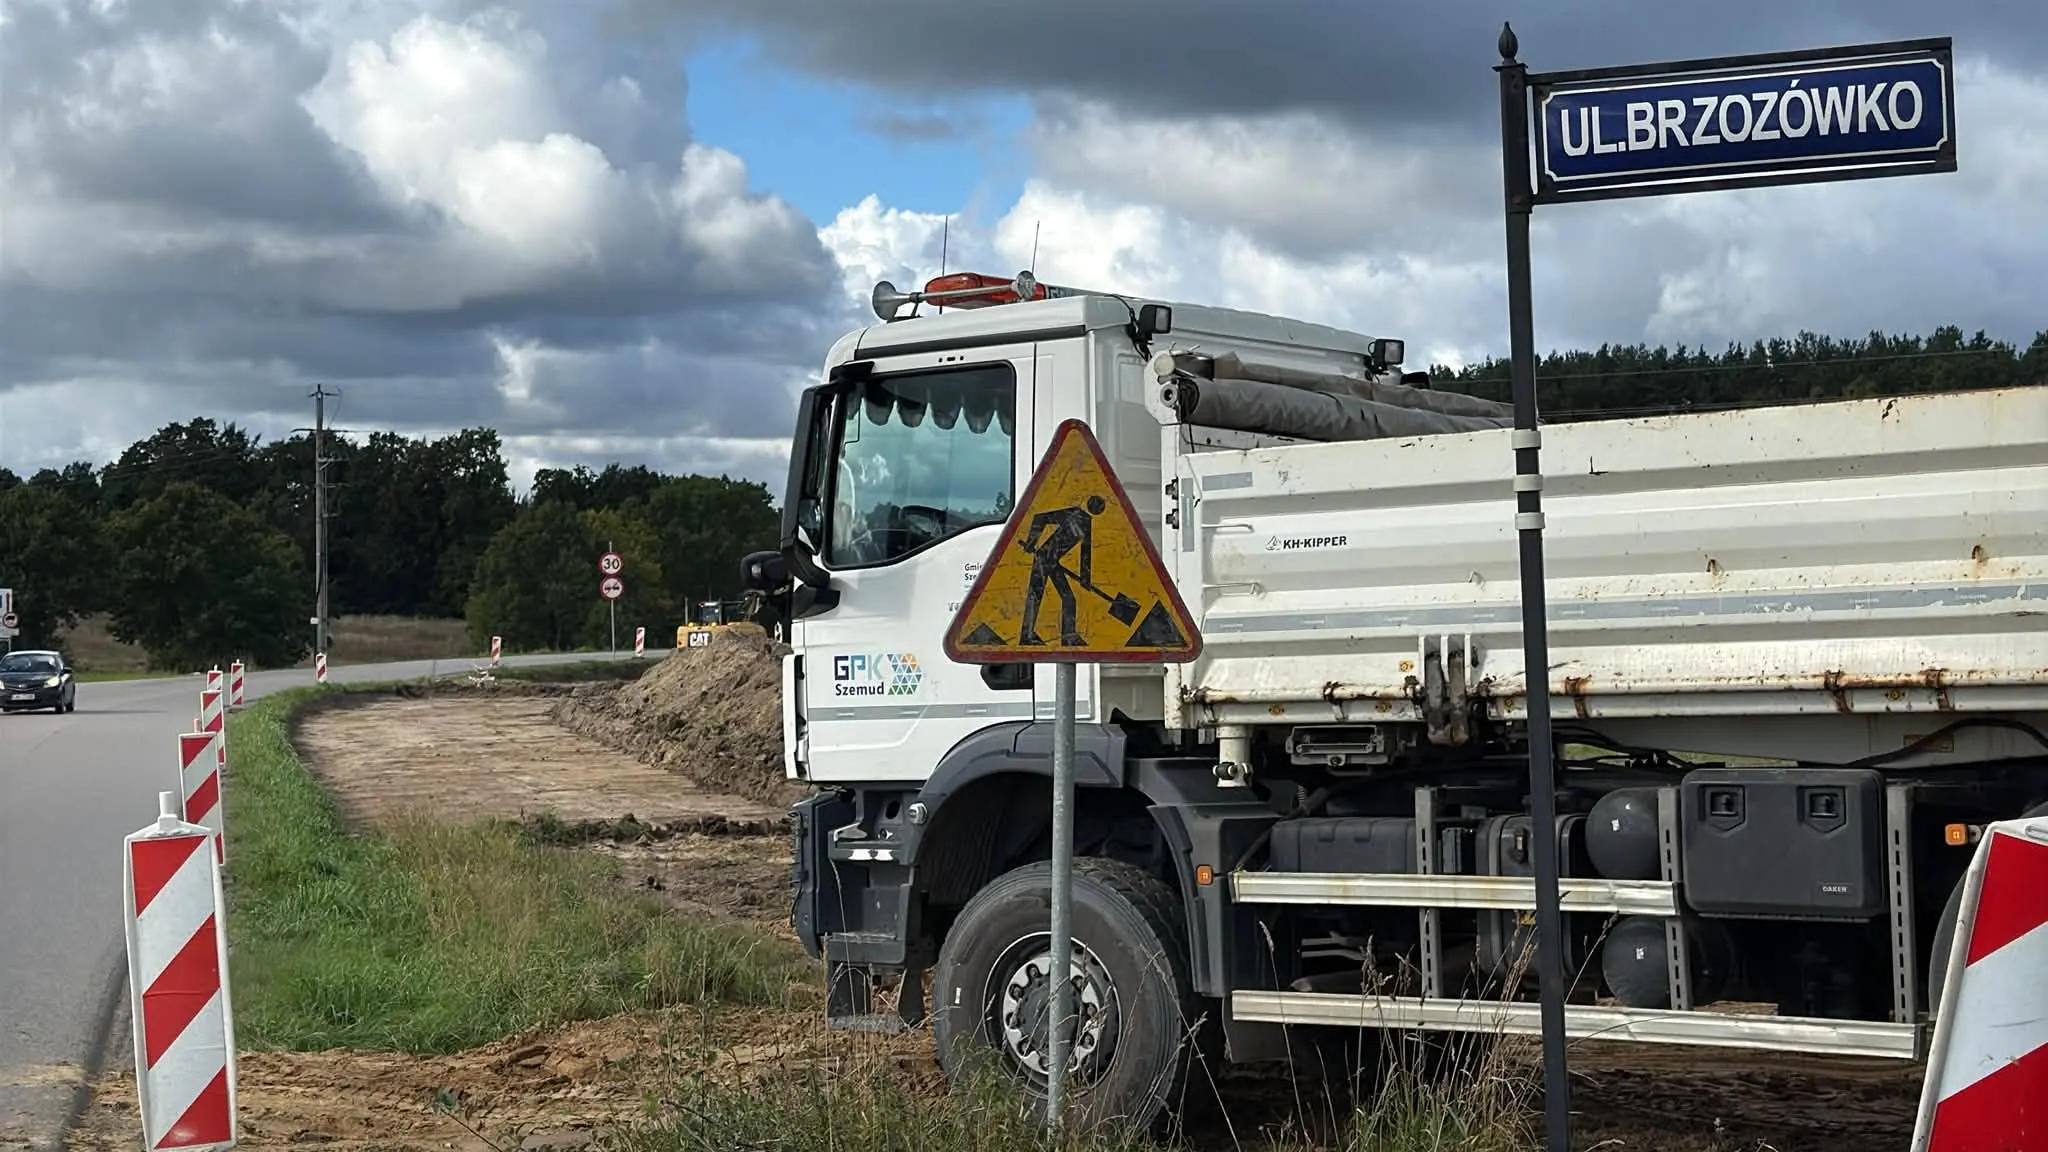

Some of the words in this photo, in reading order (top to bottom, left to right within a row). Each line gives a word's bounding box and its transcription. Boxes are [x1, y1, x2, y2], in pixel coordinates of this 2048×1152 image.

[1283, 535, 1347, 549] KH-KIPPER
[603, 558, 620, 570] 30
[689, 632, 710, 647] CAT
[834, 654, 884, 681] GPK
[835, 682, 885, 696] Szemud
